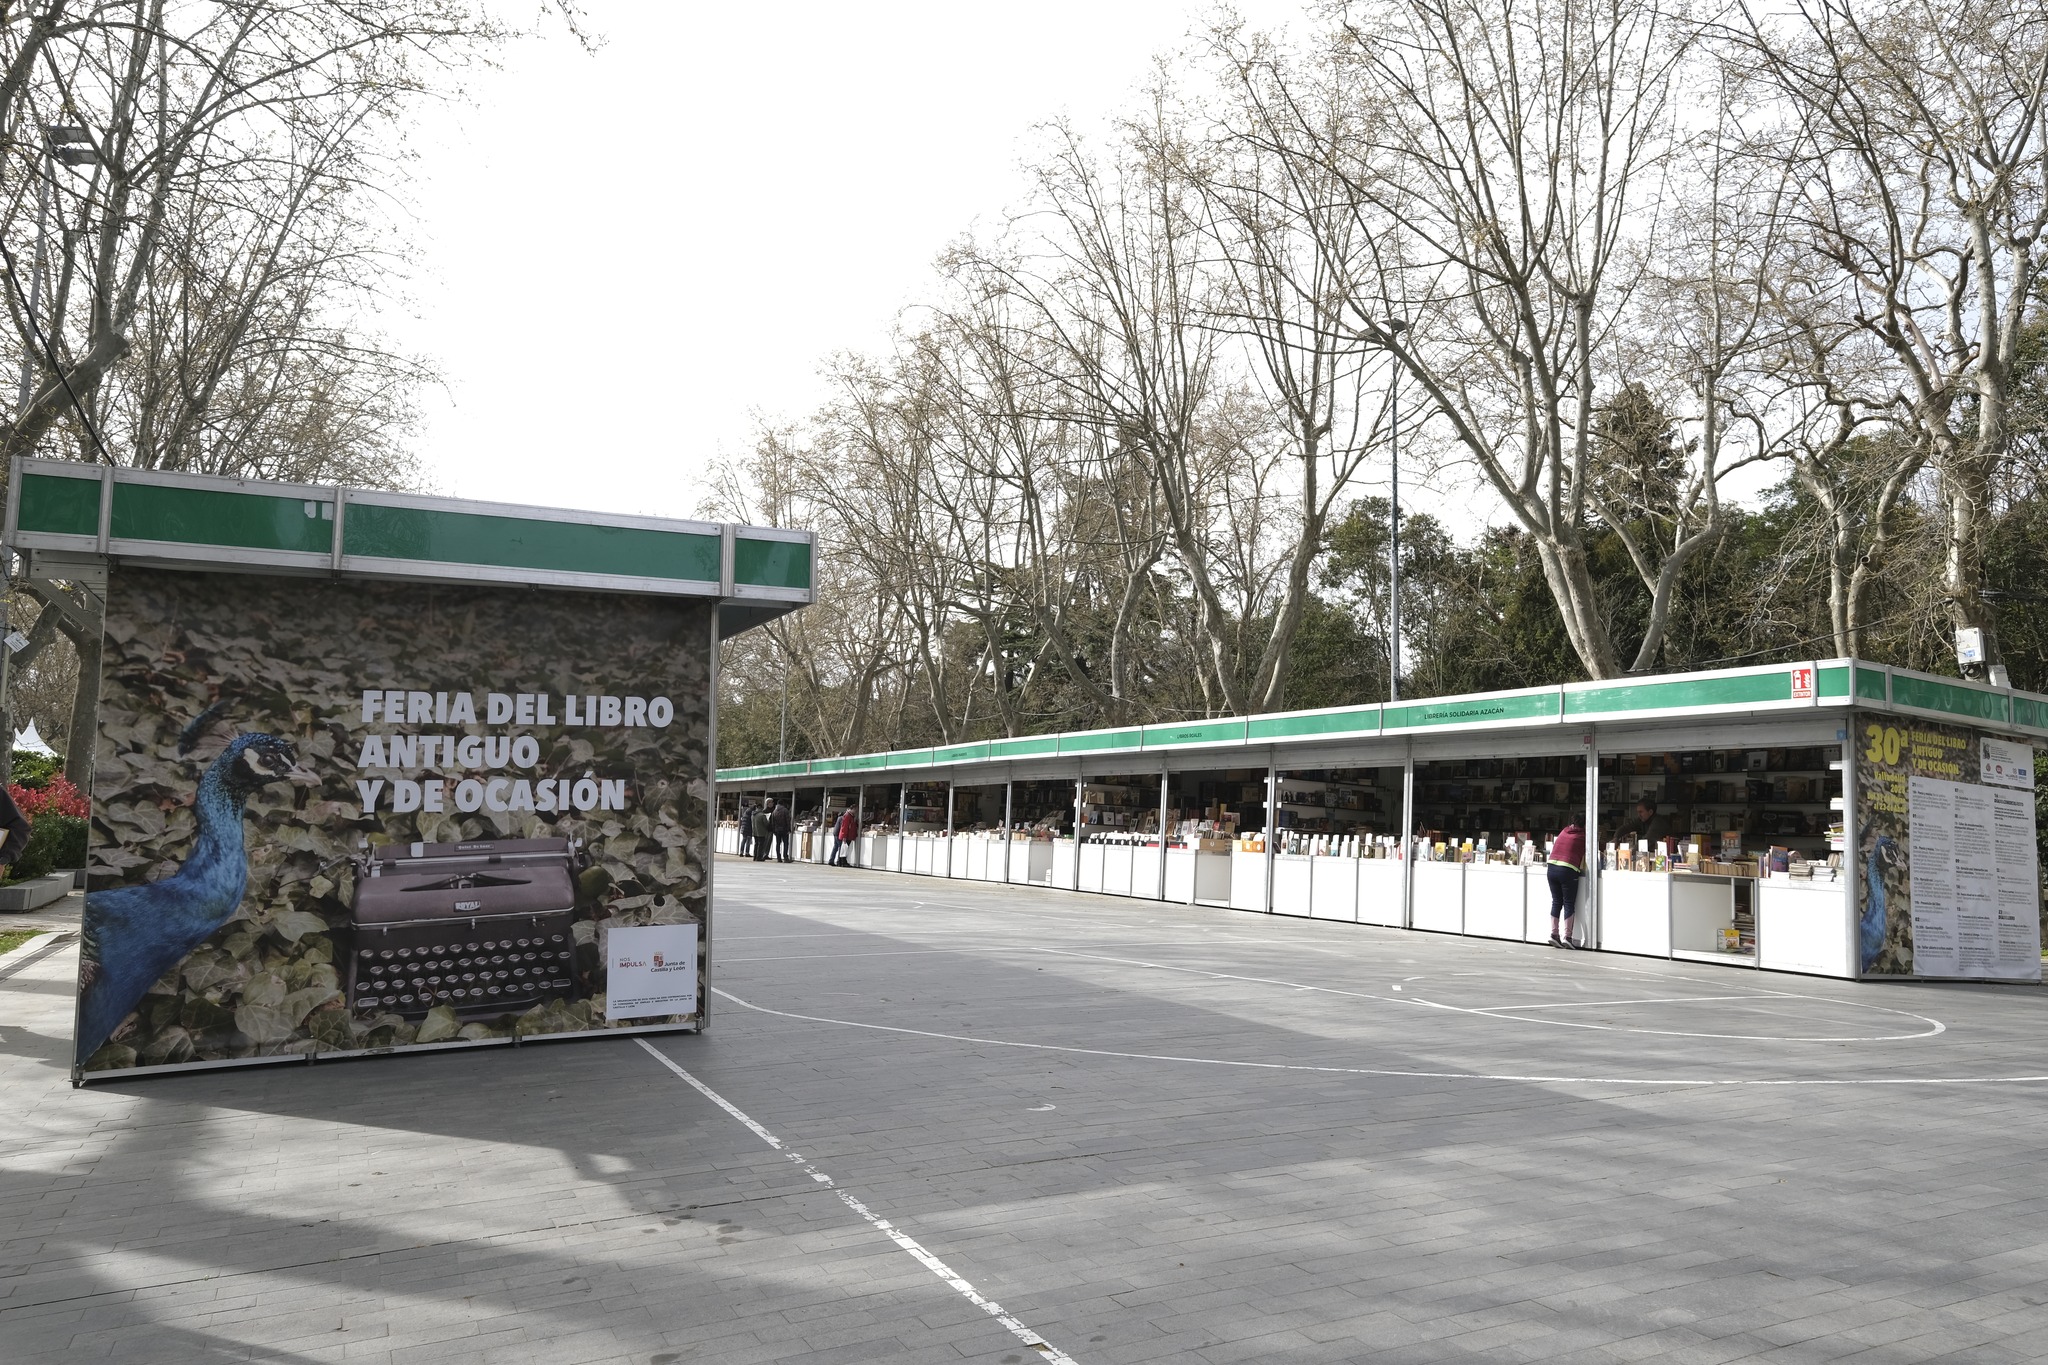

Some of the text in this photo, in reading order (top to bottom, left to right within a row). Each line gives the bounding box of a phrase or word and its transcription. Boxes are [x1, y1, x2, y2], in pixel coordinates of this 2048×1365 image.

[361, 690, 674, 728] FERIA DEL LIBRO
[1424, 711, 1448, 719] LIBRERÍA
[1449, 709, 1479, 718] SOLIDARIA
[1912, 732, 1966, 749] FERIA DEL LIBRO
[357, 735, 540, 769] ANTIGUO
[1912, 744, 1942, 758] ANTIGUO
[1912, 758, 1959, 774] Y DE OCASIÓN
[356, 771, 625, 813] Y DE OCASIÓN
[455, 901, 480, 910] ROYAL
